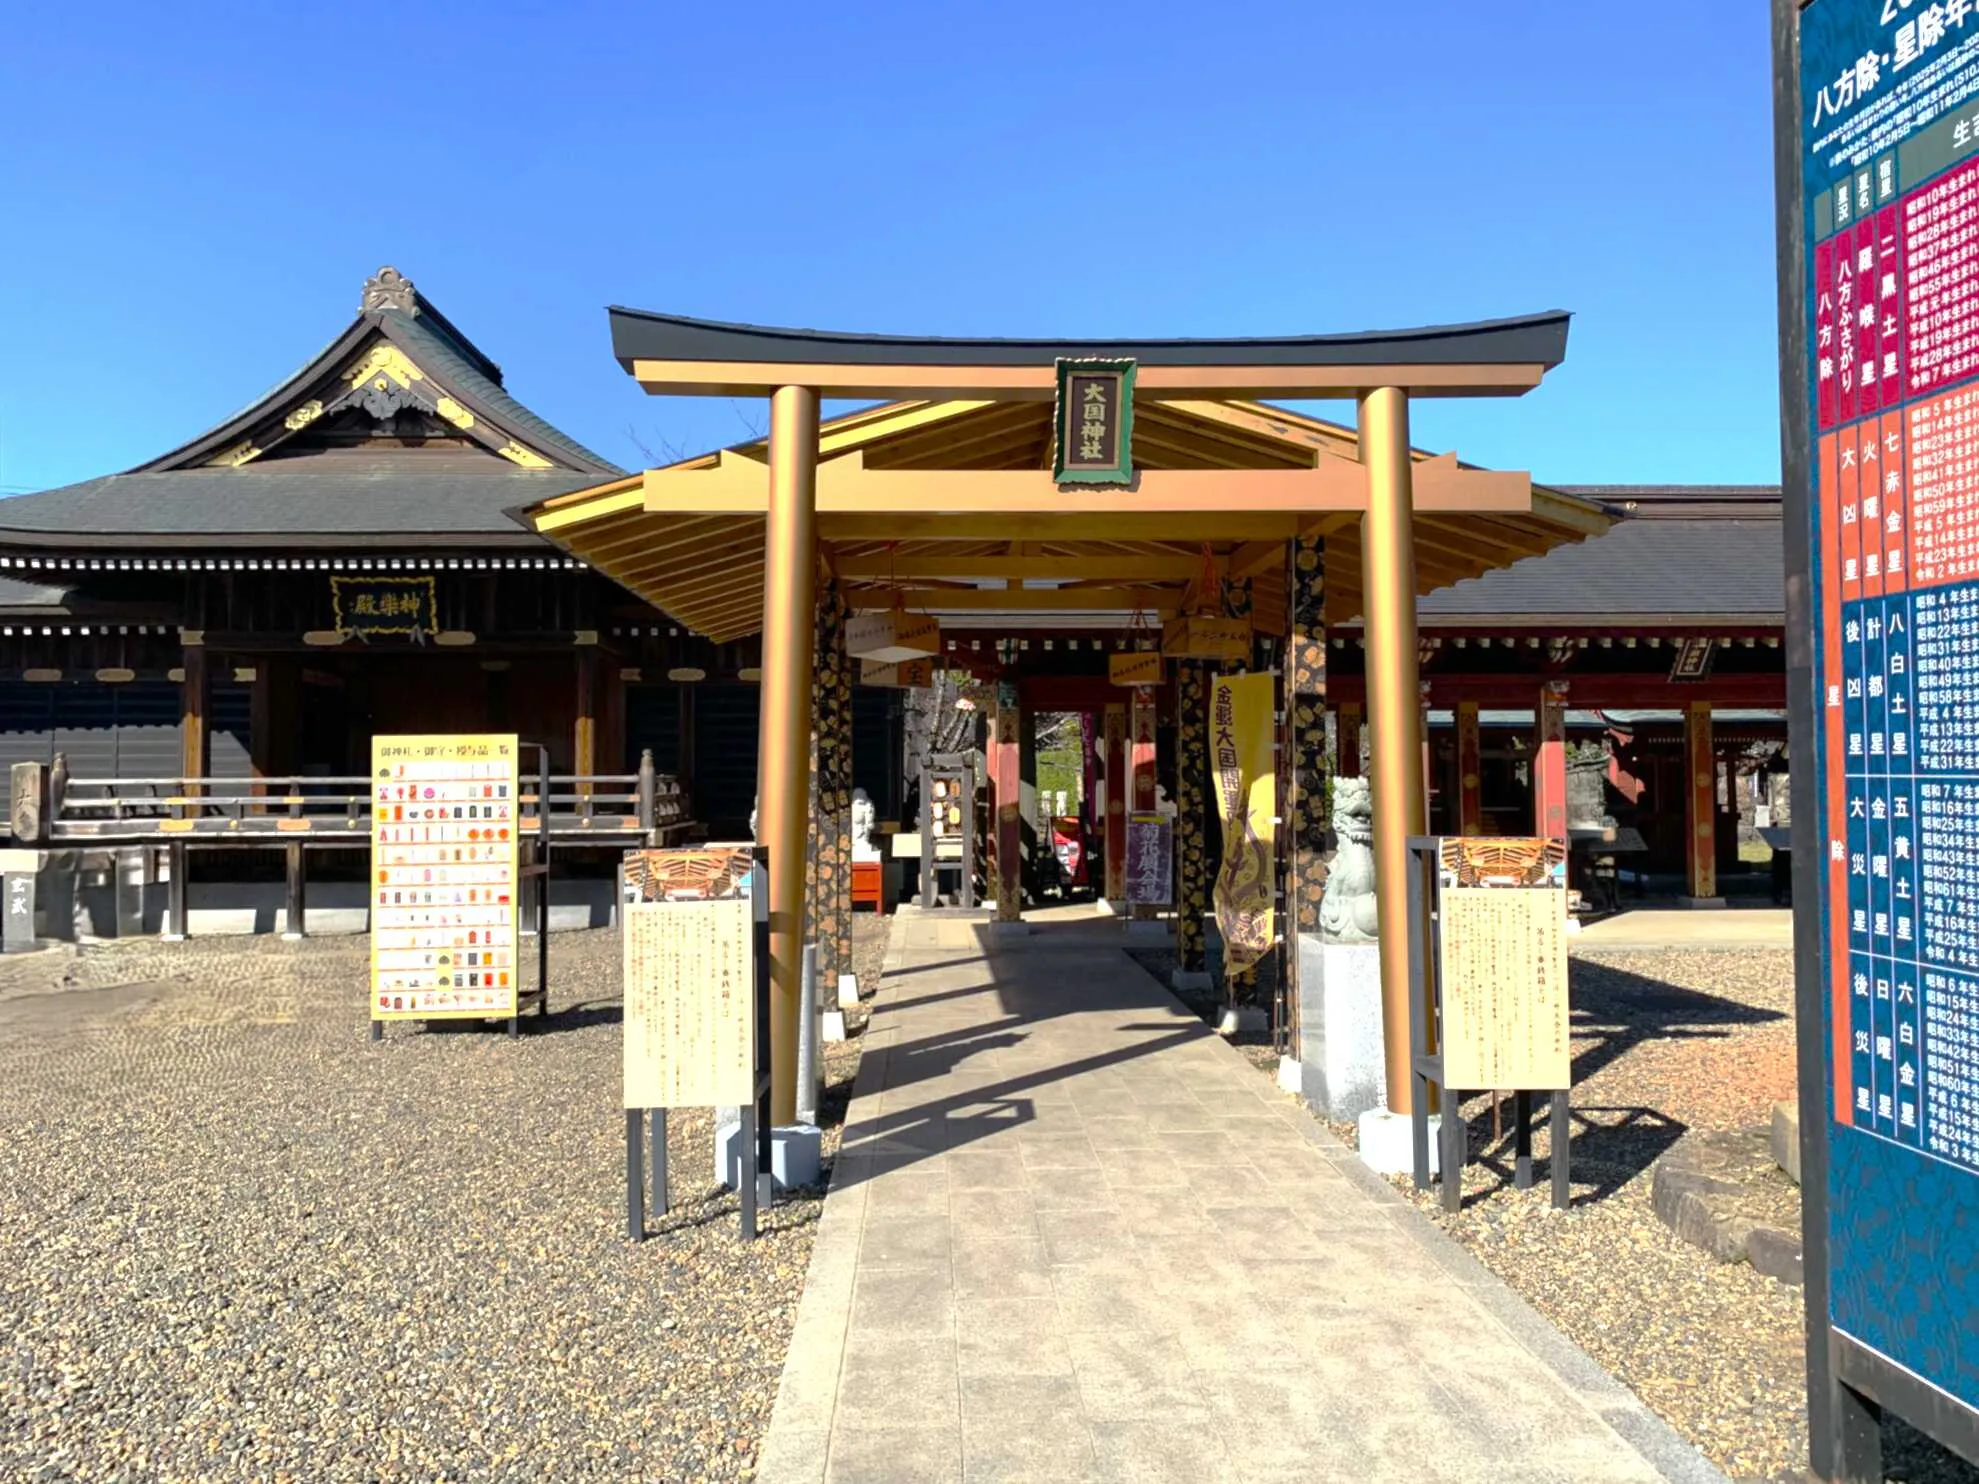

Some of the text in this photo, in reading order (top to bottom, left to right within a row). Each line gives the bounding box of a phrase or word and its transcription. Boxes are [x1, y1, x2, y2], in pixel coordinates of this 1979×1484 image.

[1819, 292, 1834, 381] 八方除
[1838, 260, 1853, 393] 八方ふさがり
[1080, 383, 1107, 460] 大国神社
[1842, 448, 1858, 581] 大凶星
[1884, 431, 1902, 573] 七赤金星
[1915, 542, 1979, 563] 平成23年生ま
[1916, 559, 1979, 580] 令和2年生ま
[1845, 620, 1863, 755] 後凶星
[1866, 617, 1884, 755] 計都星
[1889, 612, 1908, 755] 八白土星
[1850, 796, 1868, 933] 大災星
[1871, 796, 1889, 937] 金曜星
[1894, 797, 1913, 941] 五黄土星
[1923, 864, 1979, 882] 昭和52年生
[1923, 880, 1979, 899] 昭和61年生
[1924, 896, 1979, 916] 平成7年生
[1924, 912, 1979, 932] 平成16年生
[1854, 973, 1872, 1112] 後災星
[1876, 979, 1893, 1120] 日曜星
[1898, 981, 1916, 1128] 六白金星
